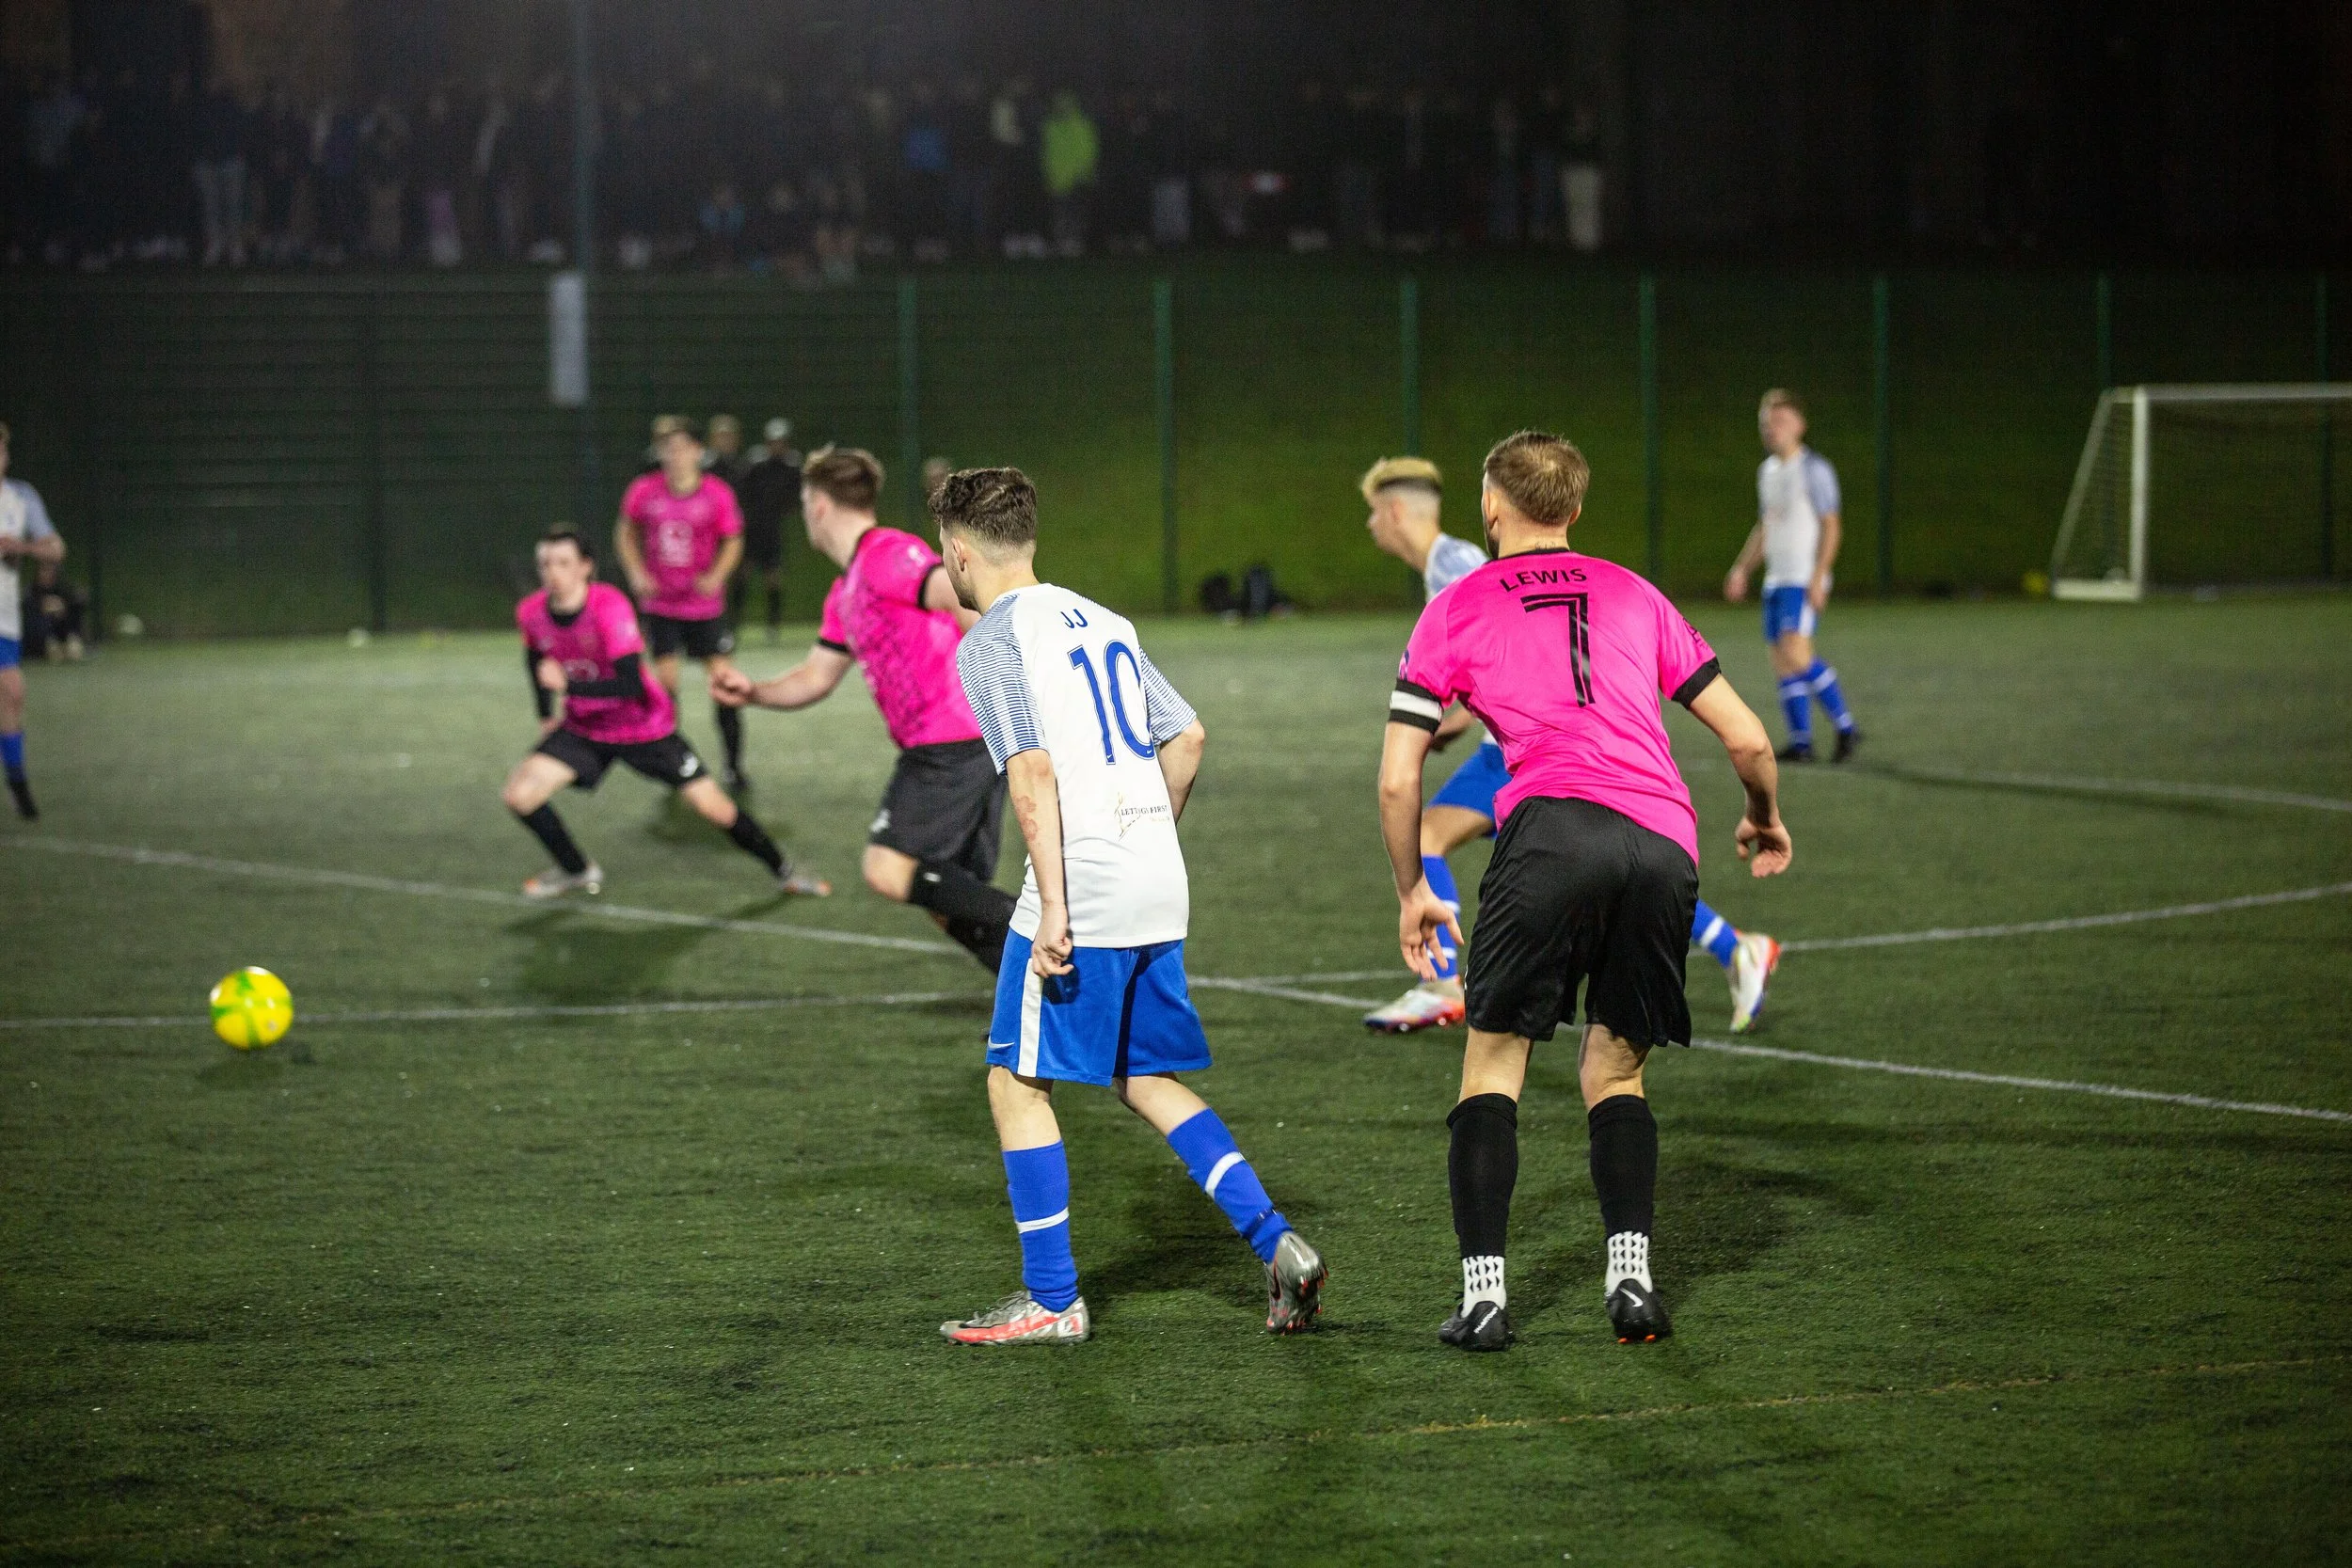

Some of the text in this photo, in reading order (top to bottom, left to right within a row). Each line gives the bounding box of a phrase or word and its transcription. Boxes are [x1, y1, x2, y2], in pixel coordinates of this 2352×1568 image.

[1500, 568, 1587, 592] LEWIS
[1060, 609, 1088, 628] JJ
[1520, 593, 1596, 707] 7
[1067, 640, 1155, 765] 10
